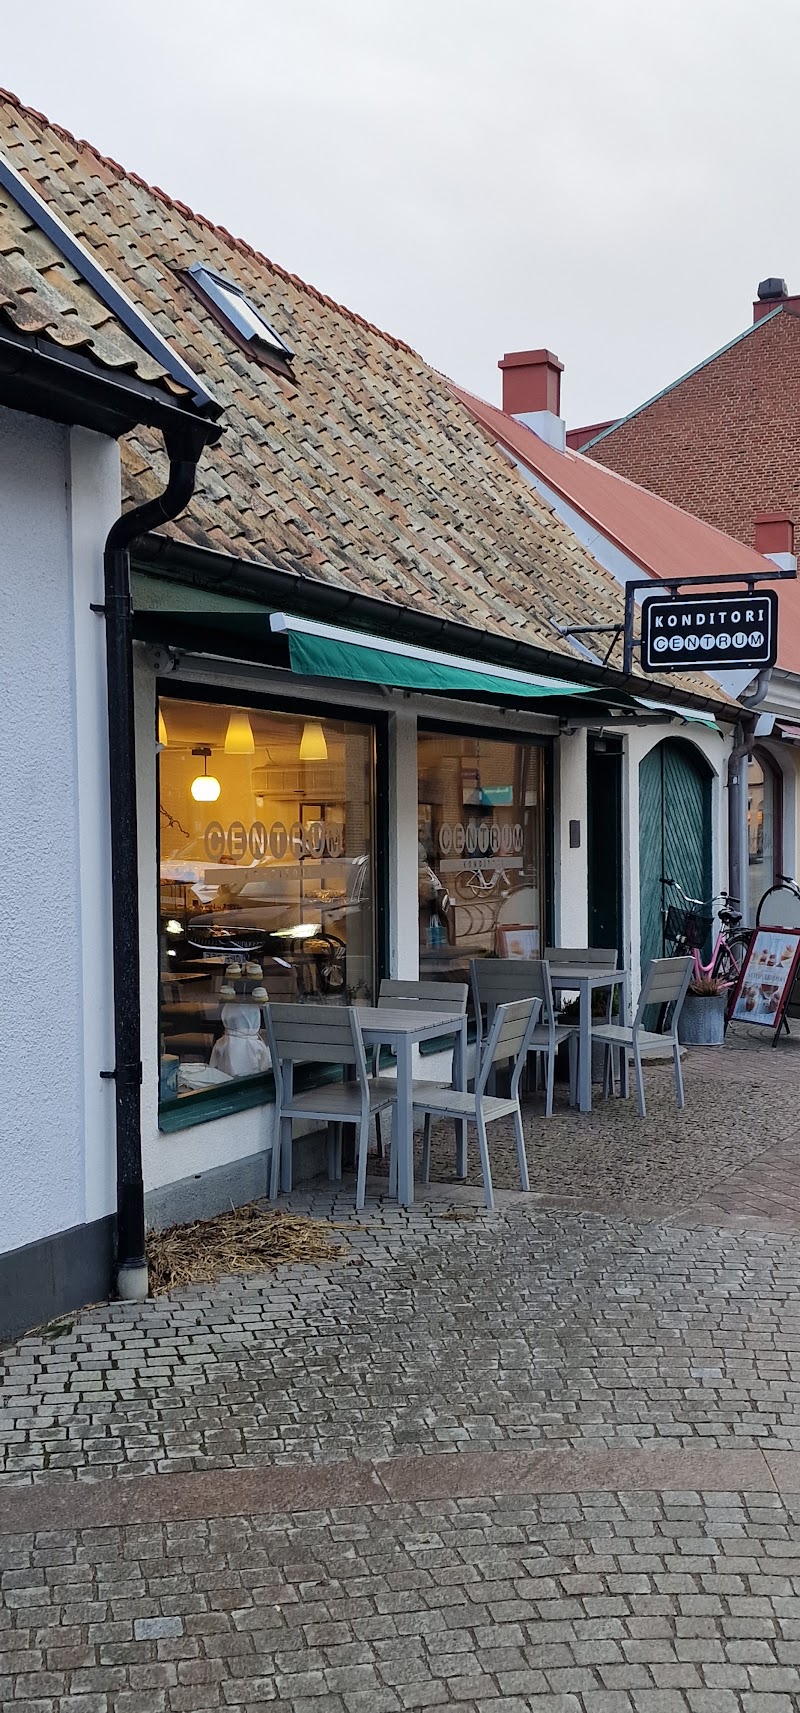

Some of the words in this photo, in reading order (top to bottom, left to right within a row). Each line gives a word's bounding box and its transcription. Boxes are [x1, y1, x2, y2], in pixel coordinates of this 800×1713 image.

[655, 609, 764, 628] KONDITORI
[655, 633, 763, 651] CENTRUM
[206, 823, 343, 859] CENTRUM
[440, 824, 523, 853] CENTRUM
[463, 858, 504, 869] KONDITI
